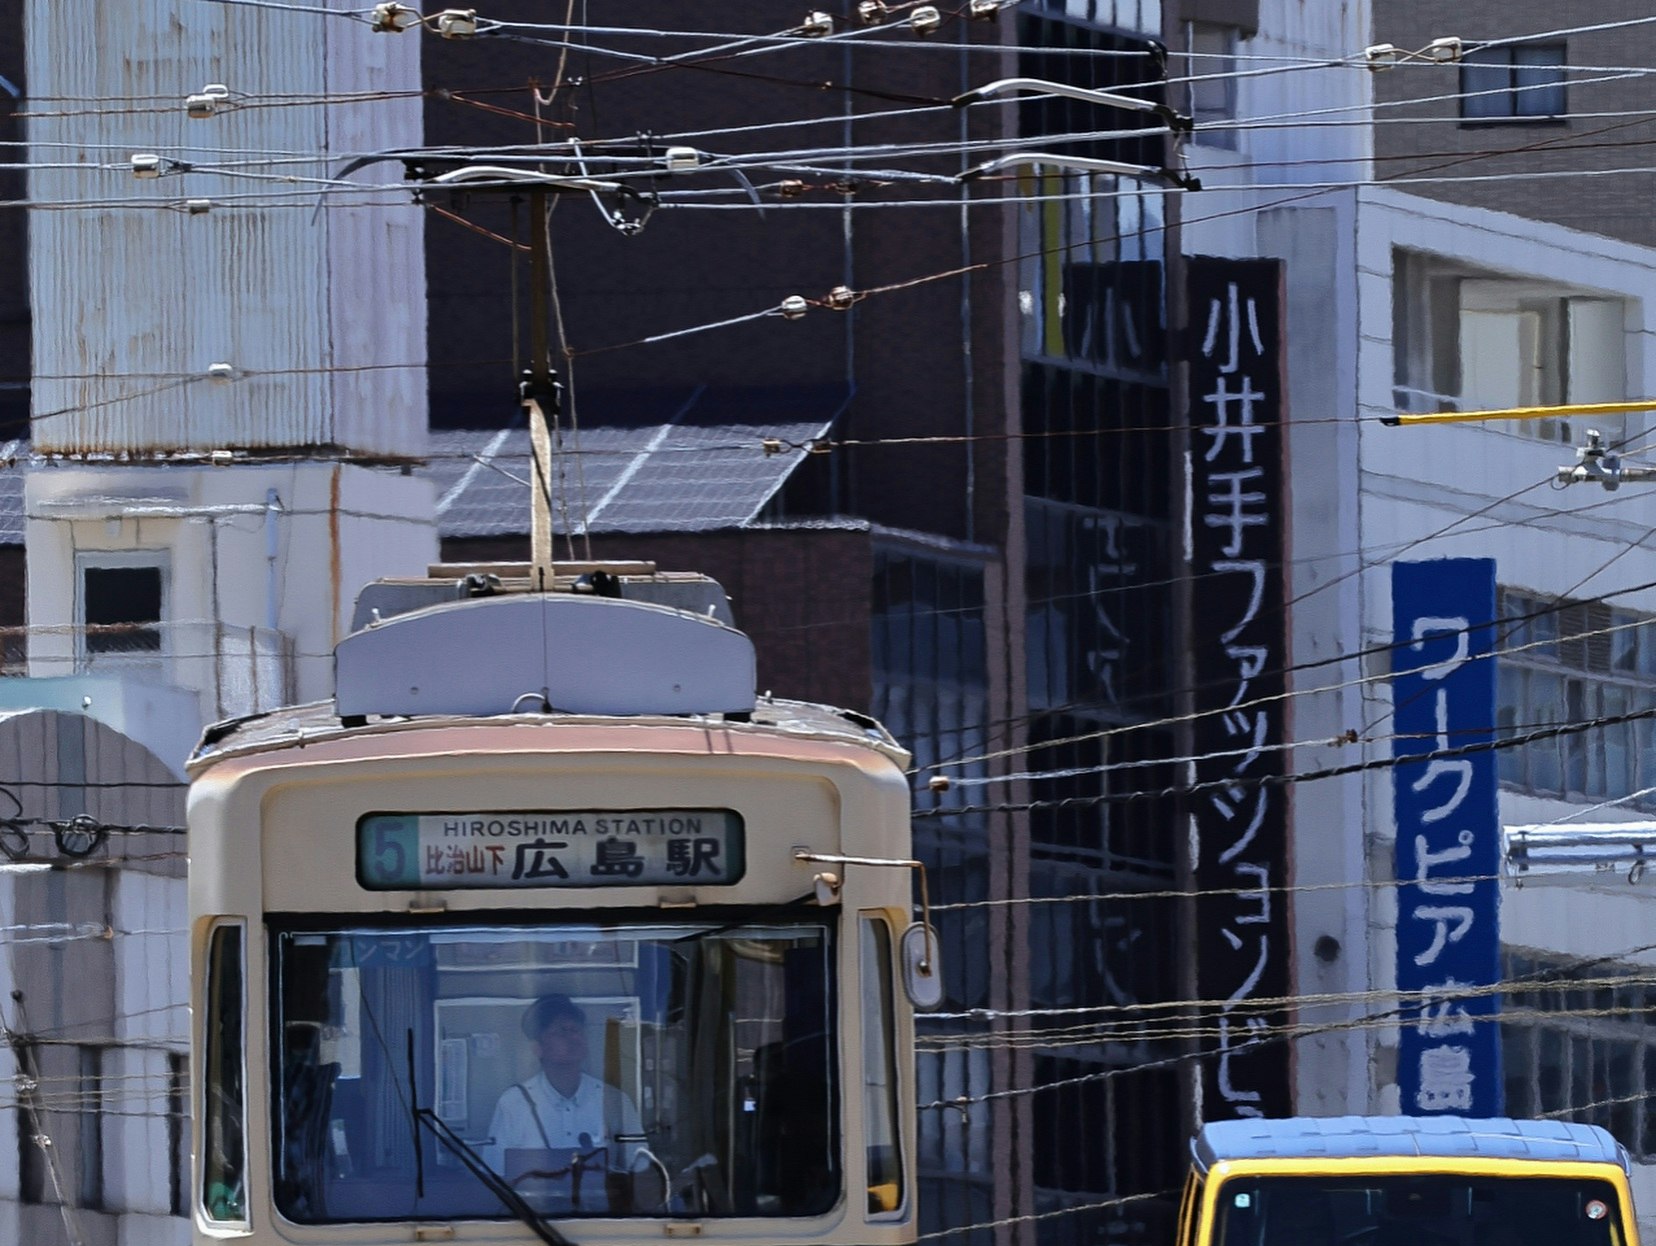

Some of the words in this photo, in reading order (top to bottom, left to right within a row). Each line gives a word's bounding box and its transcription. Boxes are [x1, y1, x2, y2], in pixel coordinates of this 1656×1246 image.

[1200, 281, 1270, 1117] 小井手ファッションビ
[374, 821, 405, 881] 5
[444, 820, 587, 837] HIROSHIMA
[595, 818, 701, 836] STATION
[425, 845, 505, 876] 比治山下
[511, 838, 721, 880] 広島駅
[1411, 616, 1476, 1111] ワークピア広島
